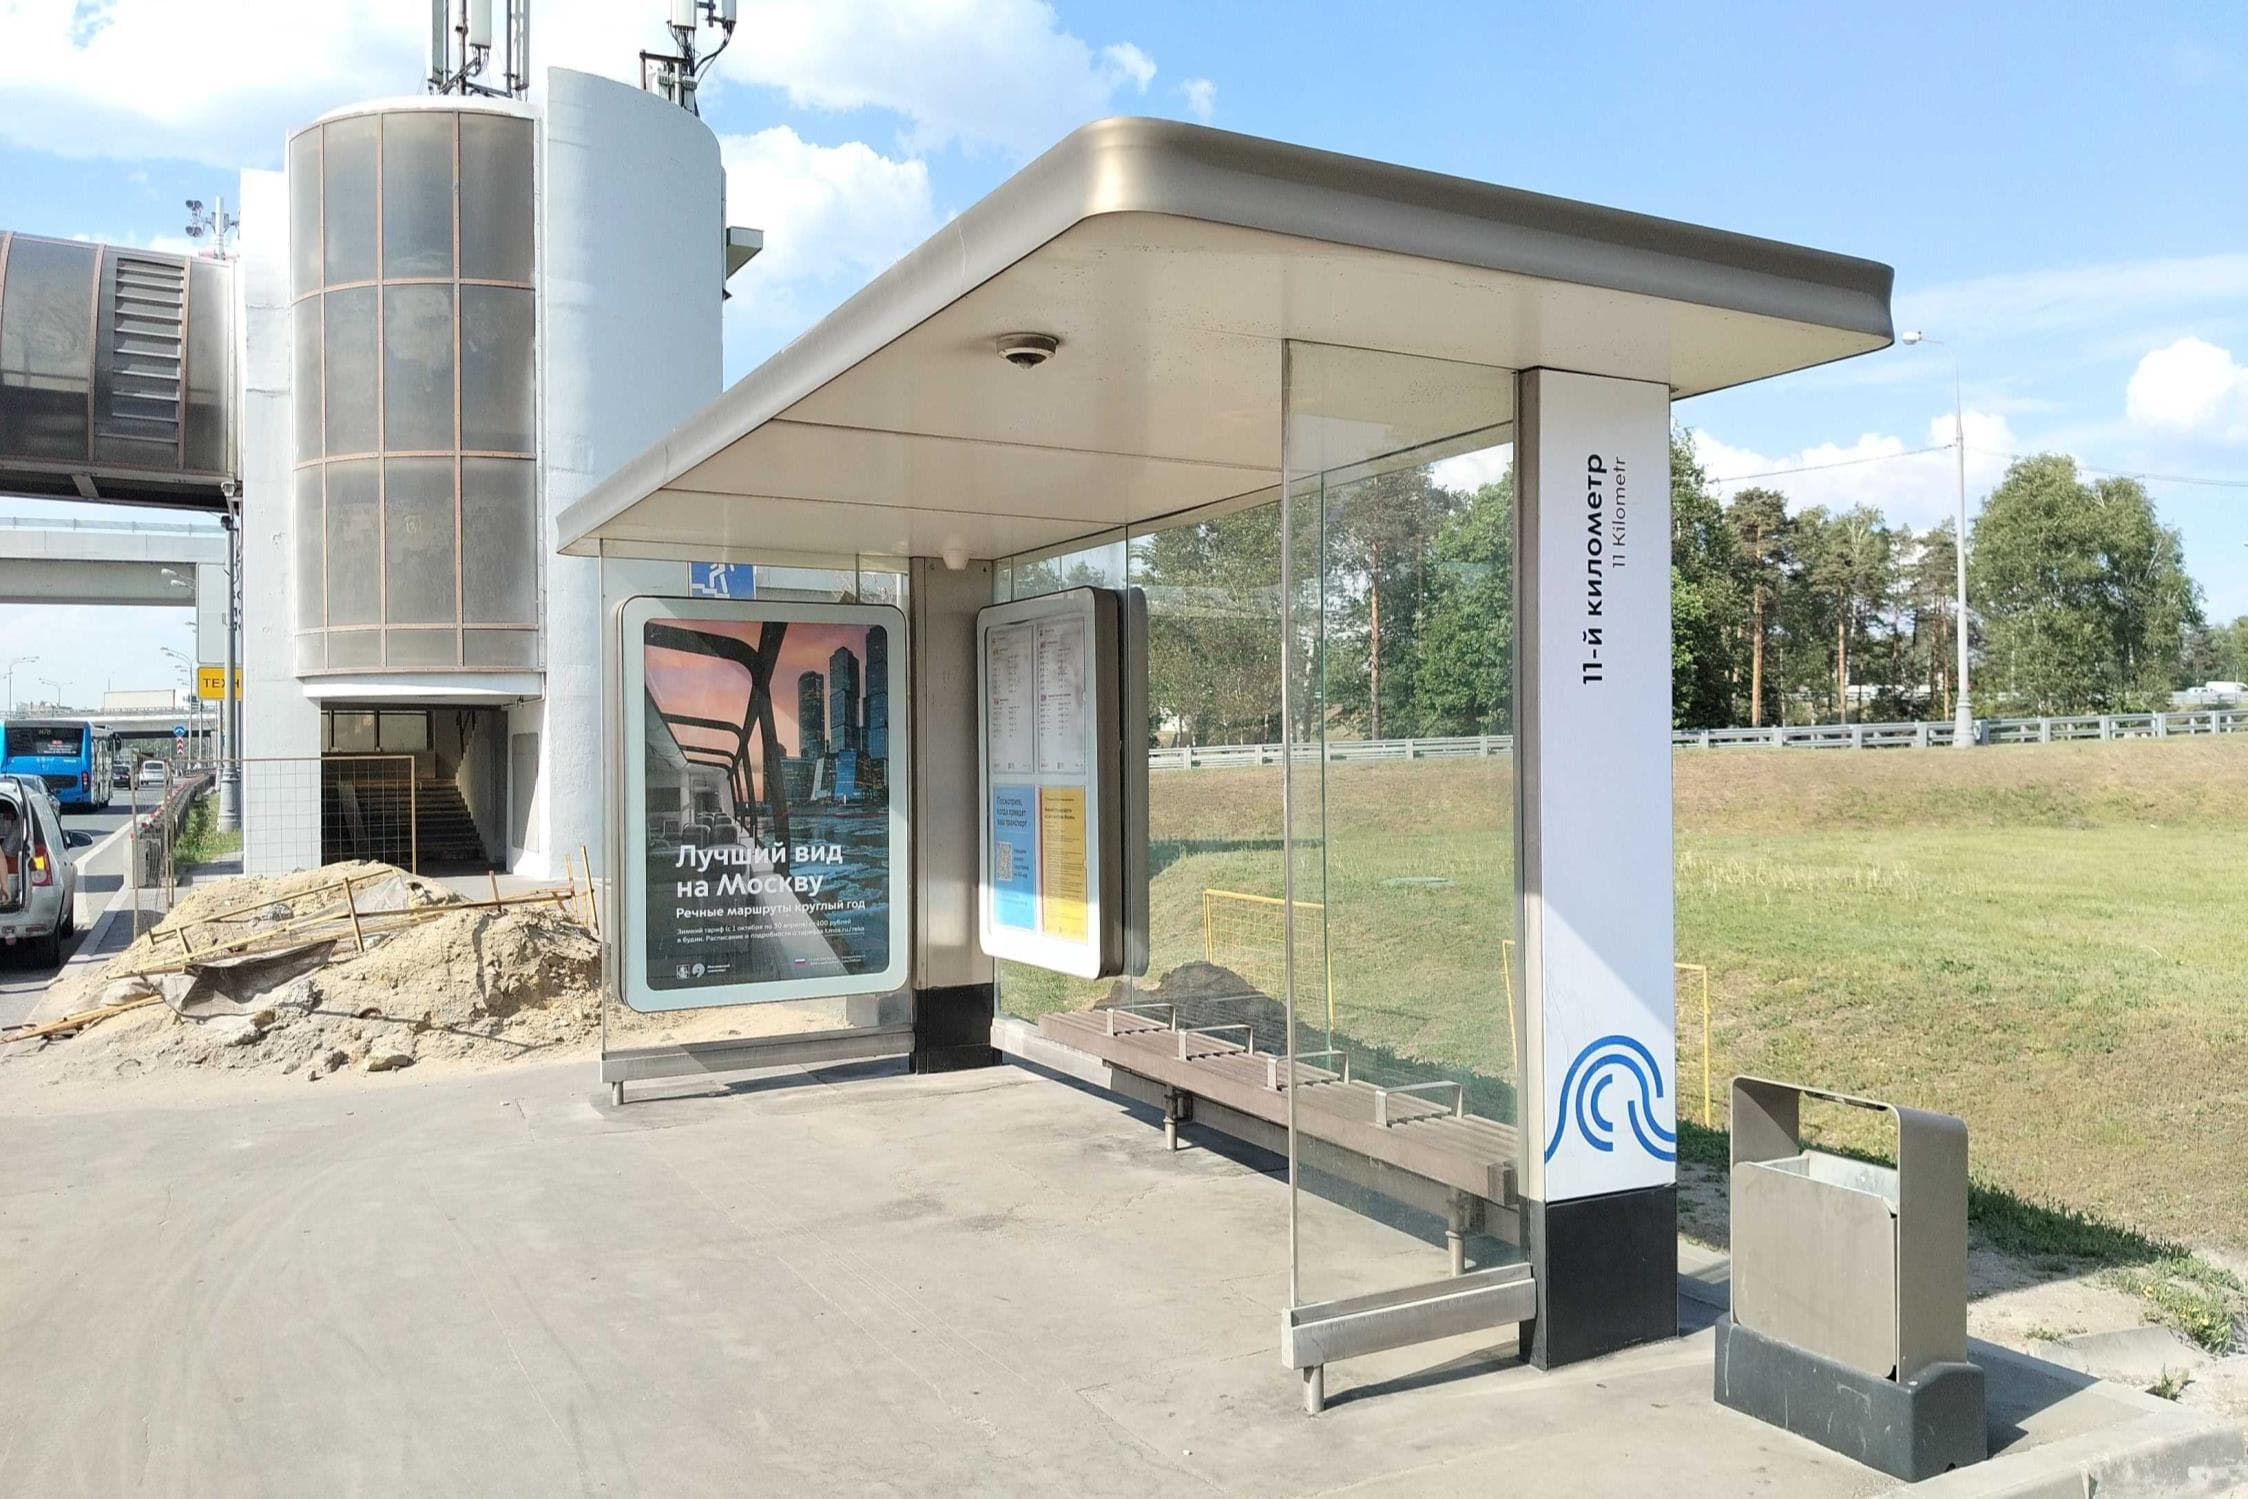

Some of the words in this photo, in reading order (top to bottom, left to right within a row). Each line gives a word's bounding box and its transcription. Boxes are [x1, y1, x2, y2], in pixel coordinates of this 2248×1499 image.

[1612, 456, 1626, 547] Kilometr
[1587, 453, 1607, 616] километр
[1612, 555, 1626, 569] 11
[1582, 628, 1603, 685] 11-й
[675, 841, 786, 872] Лучший
[795, 844, 843, 865] вид
[677, 879, 709, 898] на
[716, 873, 824, 896] Москву
[676, 906, 724, 919] Речные
[727, 903, 792, 917] маршруты
[795, 900, 844, 914] круглый
[847, 900, 866, 911] год
